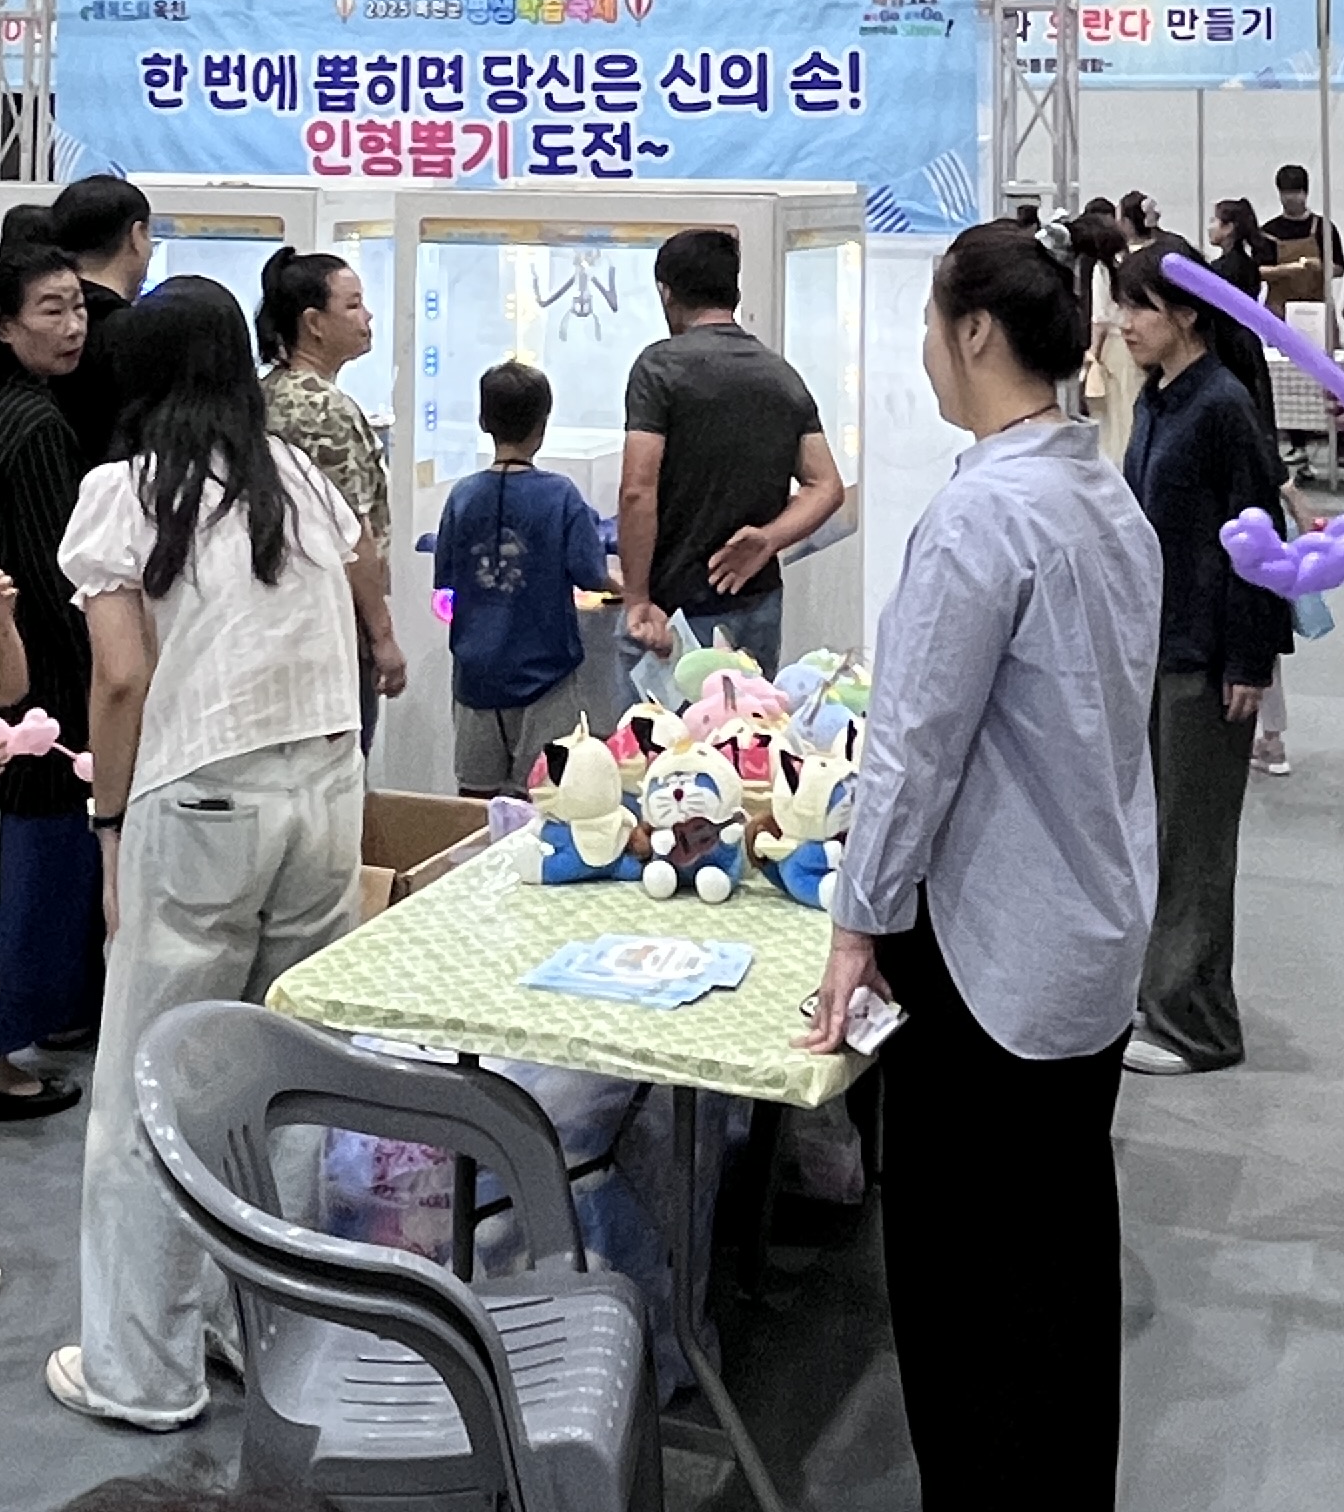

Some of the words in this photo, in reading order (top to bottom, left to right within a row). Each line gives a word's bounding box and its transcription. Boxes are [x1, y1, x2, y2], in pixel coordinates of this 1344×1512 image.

[1166, 6, 1273, 42] 만들기
[141, 52, 189, 110] 한
[204, 54, 298, 112] 번에
[314, 54, 464, 113] 뽑히면
[483, 53, 642, 114] 당신은
[660, 52, 768, 112] 신의
[789, 50, 861, 112] 손!
[306, 119, 508, 180] 인형뽑기
[528, 121, 669, 179] 도전~
